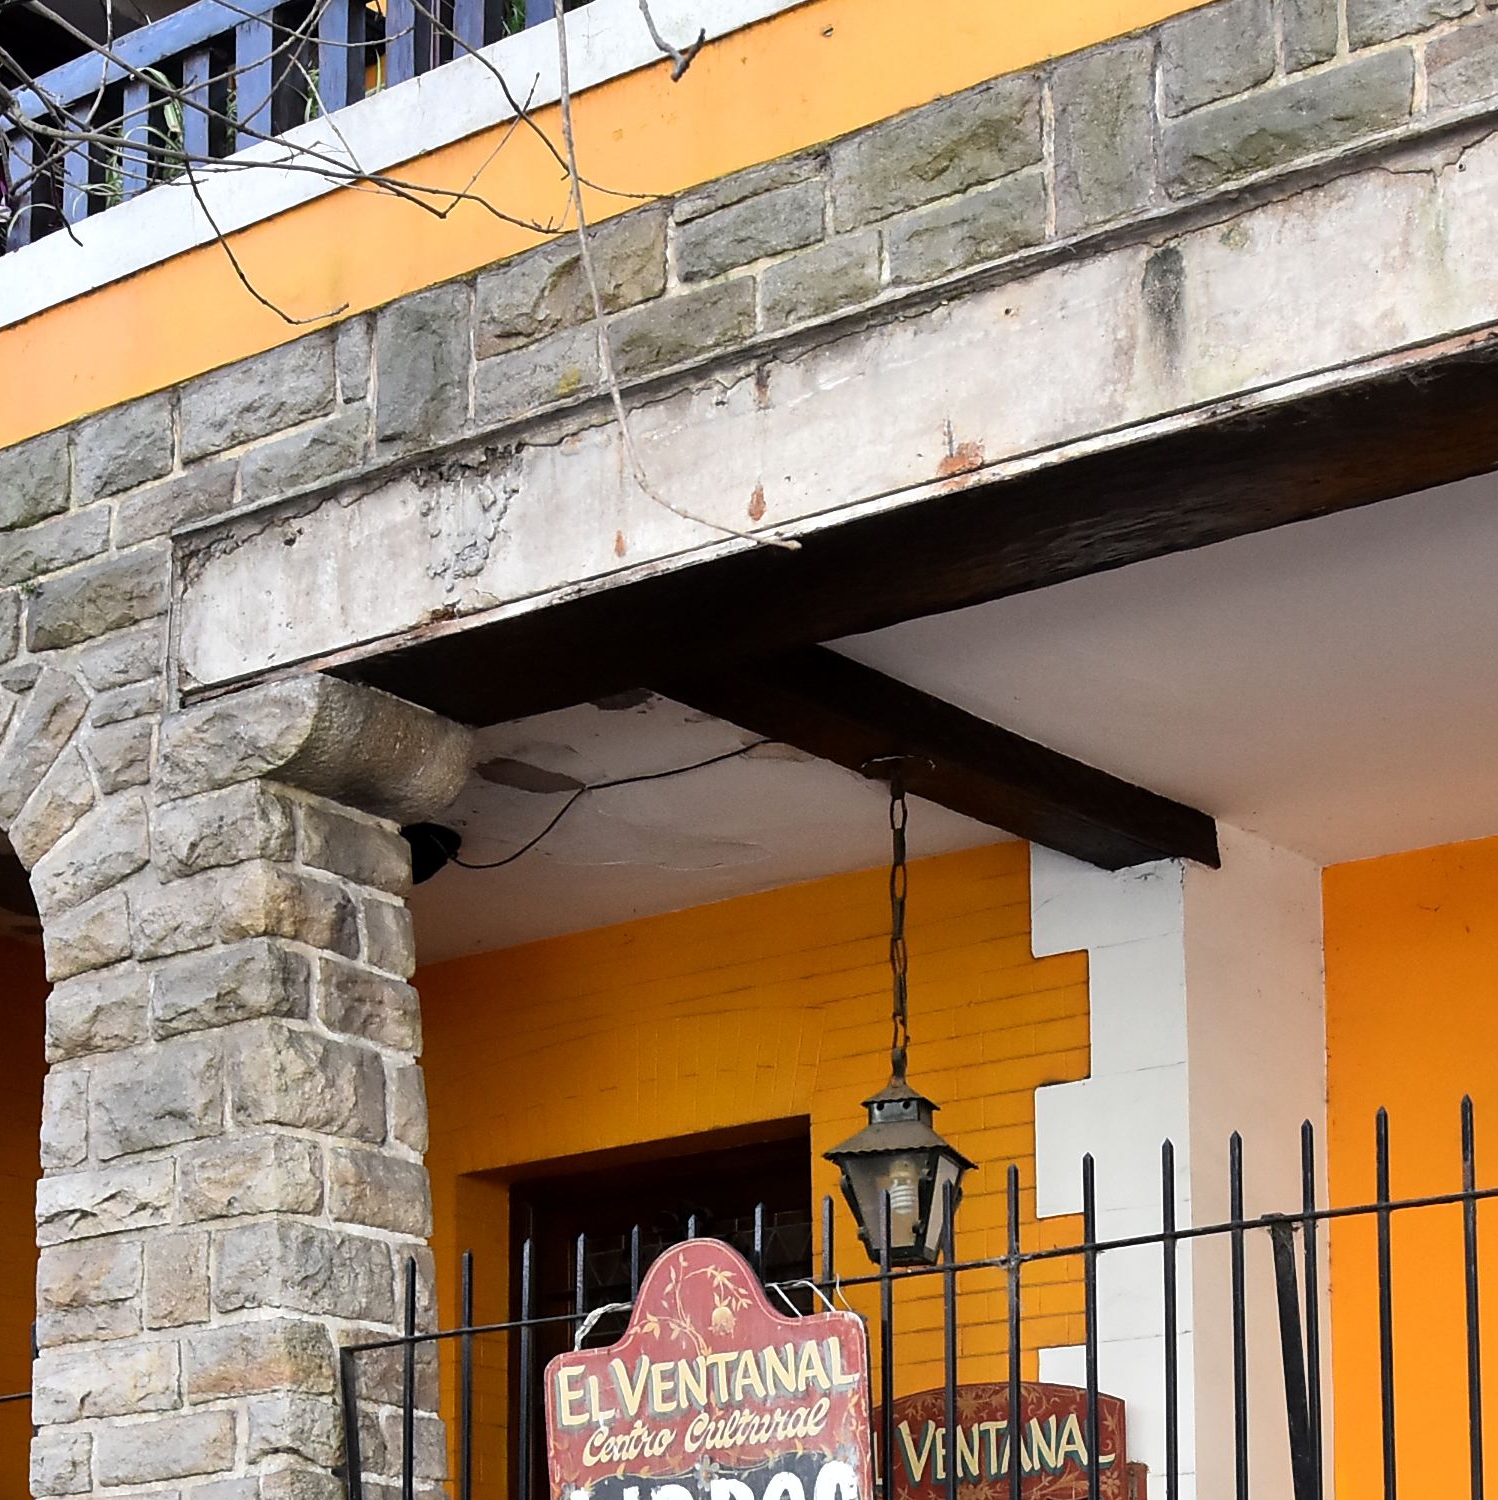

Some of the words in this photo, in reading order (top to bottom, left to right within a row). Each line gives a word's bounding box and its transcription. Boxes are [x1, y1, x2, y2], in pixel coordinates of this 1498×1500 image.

[559, 1365, 615, 1426] EL
[611, 1336, 860, 1417] VENTANAL
[583, 1419, 676, 1466] Centro
[685, 1397, 830, 1452] Cultural
